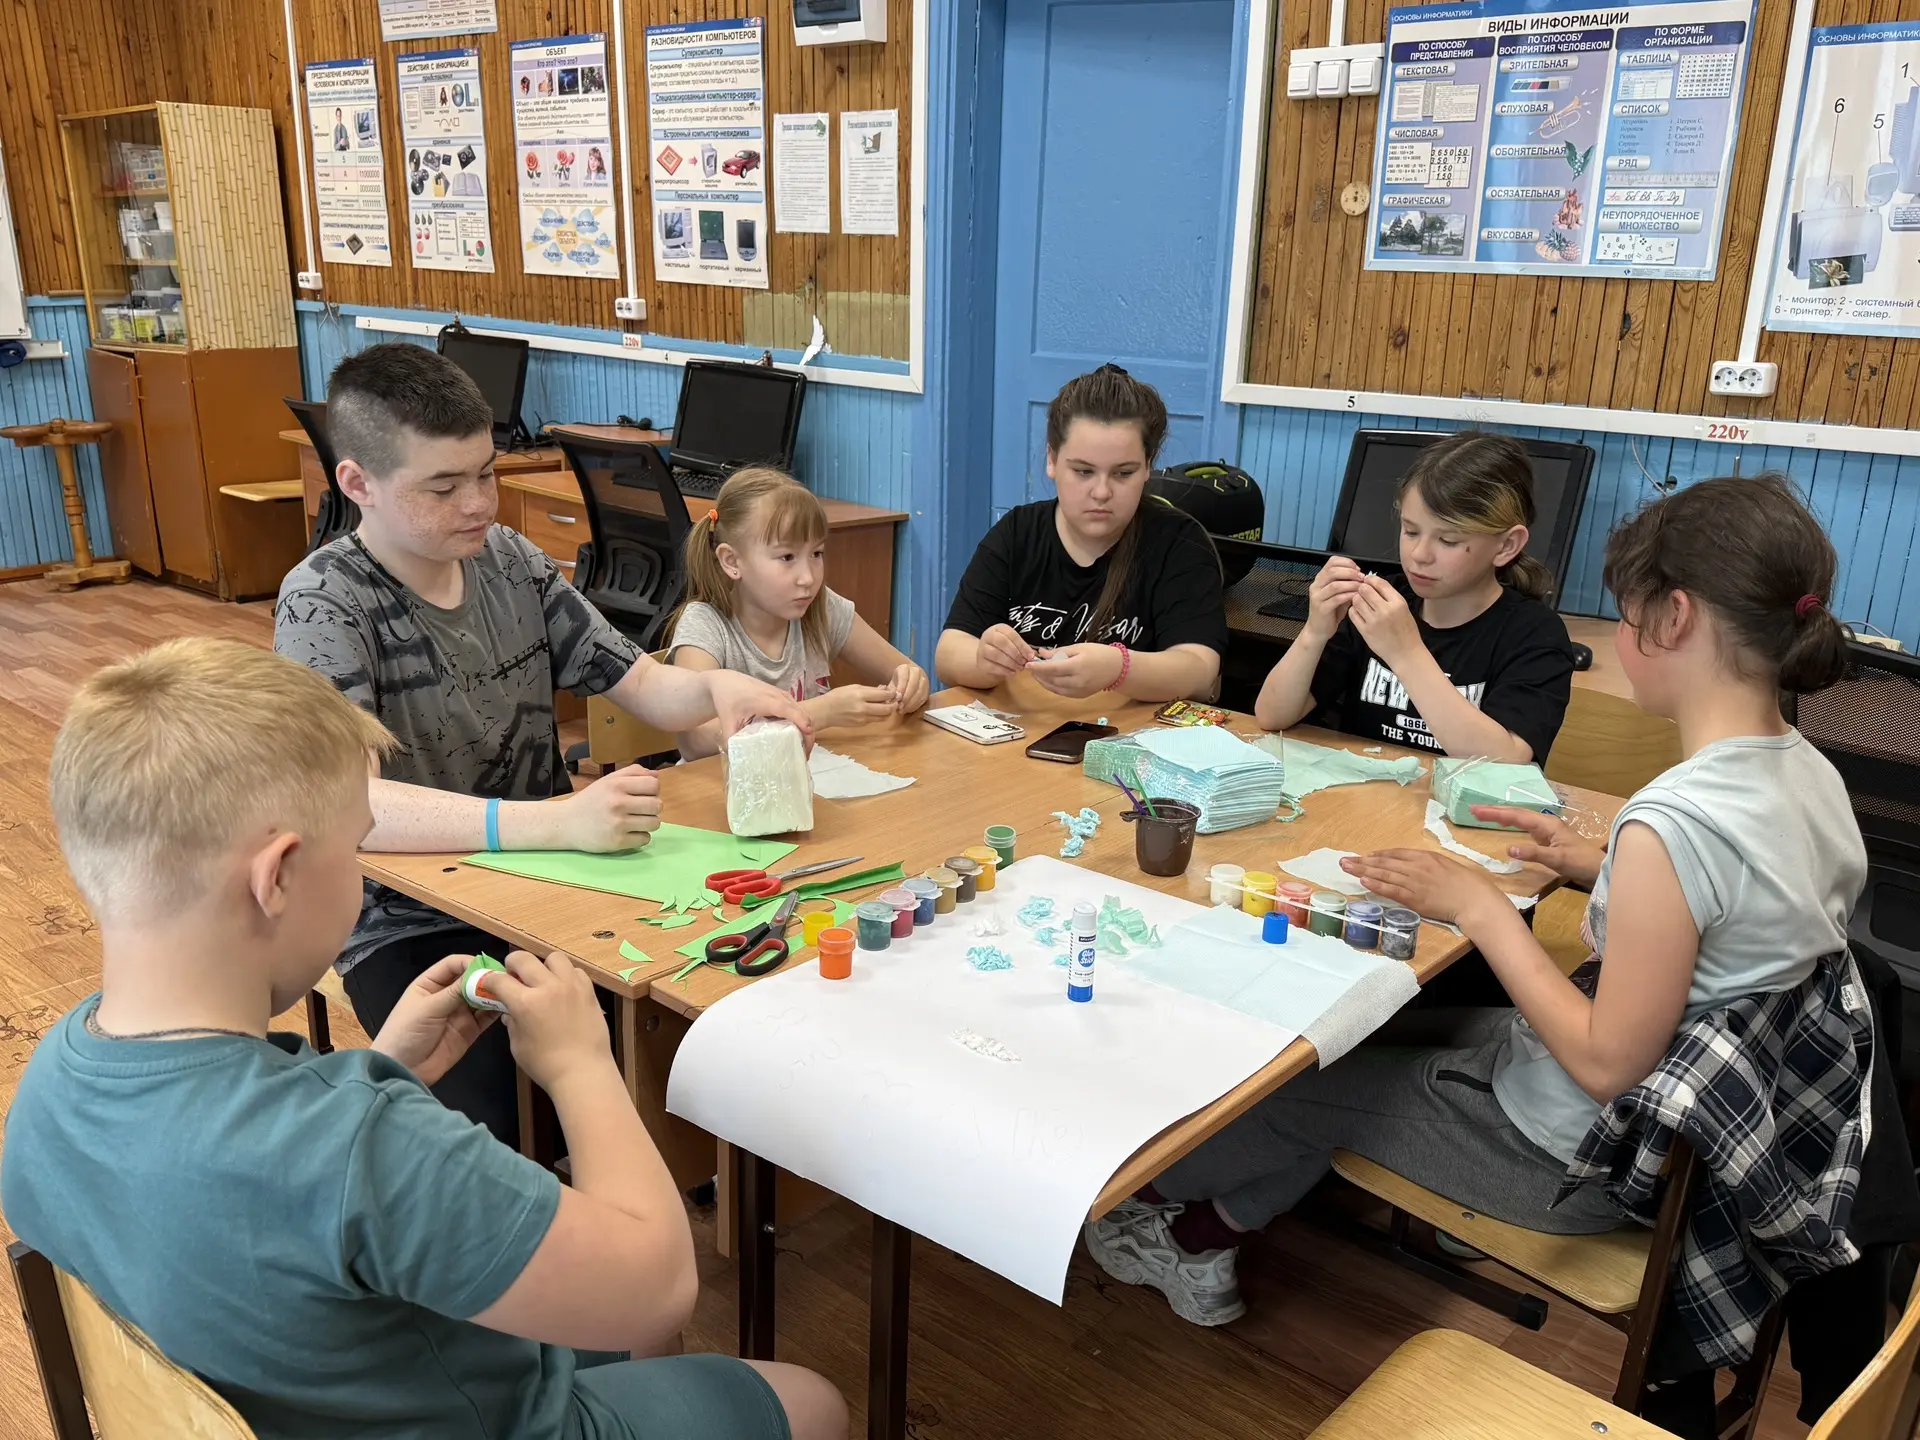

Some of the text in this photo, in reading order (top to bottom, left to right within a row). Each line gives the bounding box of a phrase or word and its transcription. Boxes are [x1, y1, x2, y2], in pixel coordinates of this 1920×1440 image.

[1393, 10, 1473, 22] ОСНОВЫ ИНФОРМАТИКИ
[1488, 12, 1629, 33] ВИДЫ ИНФОРМАЦИИ
[1655, 25, 1705, 36] ПО ФОРМЕ
[651, 30, 757, 46] РАЗНОВИДНОСТИ КОМПЬЮТЕРОВ
[1527, 33, 1583, 44] ПО СПОСОБУ
[1644, 35, 1713, 47] ОРГАНИЗАЦИИ
[1817, 34, 1856, 43] ОСНОВЫ
[1418, 40, 1467, 51] ПО СПОСОБУ
[1499, 41, 1610, 55] ВОСПРИЯТИЯ ЧЕЛОВЕКОМ
[546, 47, 567, 56] ОБЪЕКТ
[681, 47, 724, 58] Суперкомпьютер
[1410, 49, 1474, 60] ПРЕДСТАВЛЕНИЯ
[1626, 53, 1672, 64] ТАБЛИЦА
[407, 63, 429, 72] ДЕЙСТВИЯ
[436, 59, 469, 69] ИНФОРМАЦИЕЙ
[1509, 59, 1569, 70] ЗРИТЕЛЬНАЯ
[1901, 62, 1909, 78] 1
[1402, 65, 1449, 76] ТЕКСТОВАЯ
[656, 91, 756, 102] Специализированный компьютер-сервер
[1500, 104, 1549, 113] СЛУХОВАЯ
[1621, 104, 1661, 114] СПИСОК
[1834, 97, 1846, 114] 6
[1873, 113, 1885, 129] 5
[663, 129, 750, 138] Встроенный компьютер-невидимка
[1395, 129, 1438, 138] ЧИСЛОВАЯ
[1495, 147, 1566, 156] ОБОНЯТЕЛЬНАЯ
[1618, 159, 1638, 168] РЯД
[675, 191, 739, 201] Персональный компьютер
[1490, 190, 1560, 198] ОСЯЗАТЕЛЬНАЯ
[1387, 196, 1446, 205] ГРАФИЧЕСКАЯ
[1602, 211, 1700, 222] НЕУПОРЯДОЧЕННОЕ
[1618, 221, 1680, 231] МНОЖЕСТВО
[1487, 231, 1533, 239] ВКУСОВАЯ
[1791, 296, 1837, 306] монитор;
[1839, 297, 1846, 305] 2
[1855, 298, 1914, 308] системный
[1774, 305, 1891, 320] 6 принтер; 7 сканер.
[1348, 396, 1355, 408] 5
[1708, 424, 1749, 440] 220v
[1403, 718, 1426, 730] 1968
[1381, 724, 1403, 740] THE
